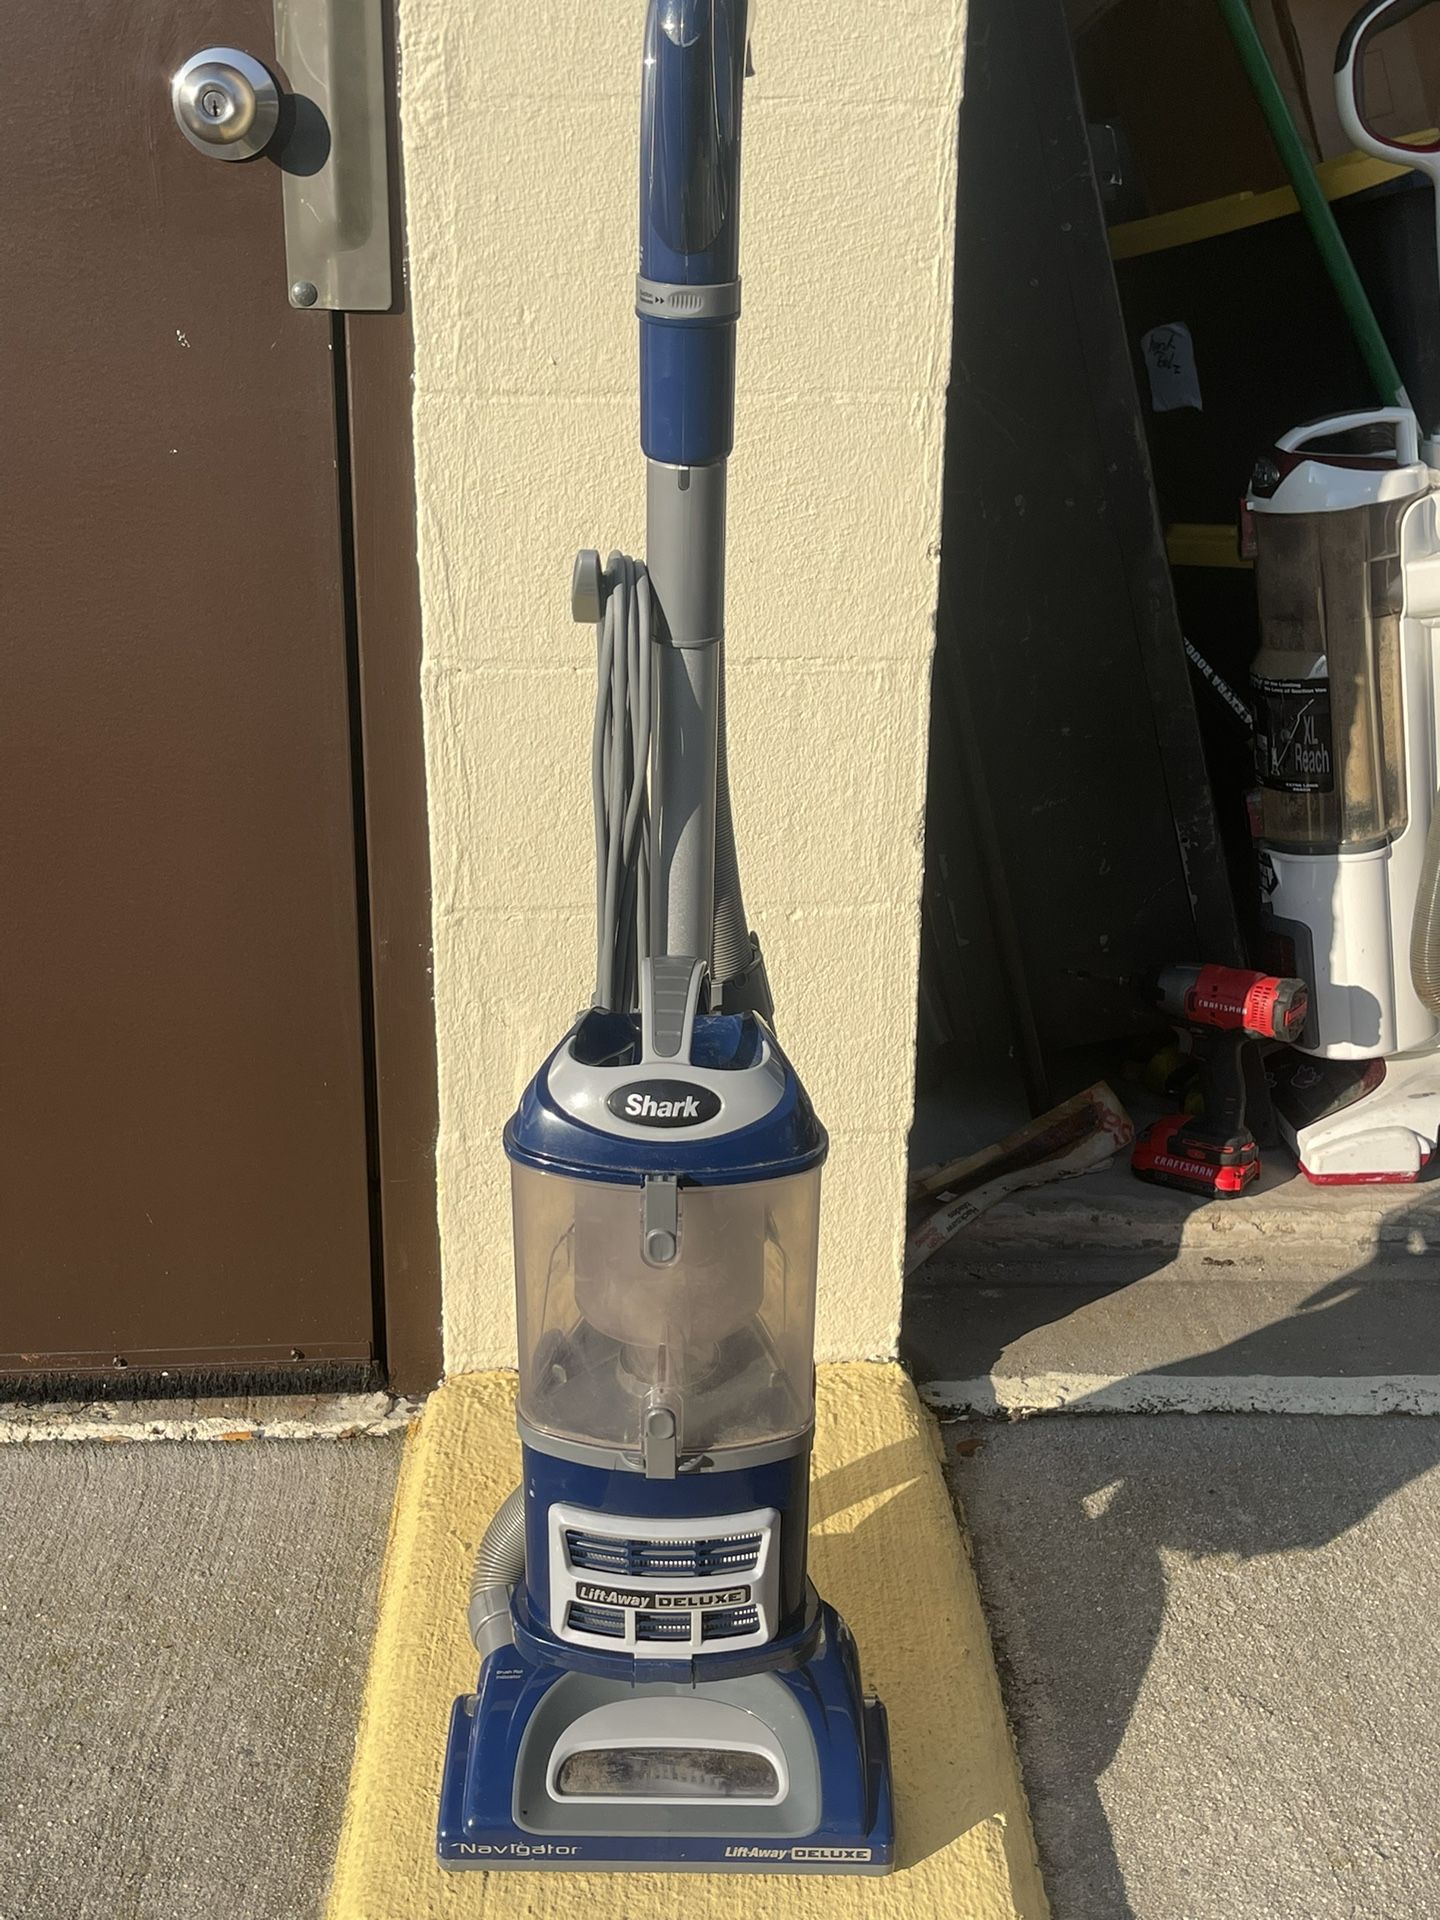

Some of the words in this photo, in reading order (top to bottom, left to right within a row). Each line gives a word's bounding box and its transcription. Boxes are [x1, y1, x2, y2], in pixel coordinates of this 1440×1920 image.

[1303, 715, 1319, 745] XL
[1295, 743, 1330, 773] Reach
[1198, 999, 1248, 1015] CRAFTSMAN
[624, 1093, 700, 1117] Shark
[1154, 1155, 1214, 1177] CRAFTSMAN
[579, 1586, 650, 1608] Lift-Away
[658, 1591, 743, 1607] DELUXE
[457, 1841, 580, 1857] Navigator
[724, 1846, 788, 1860] Lift-Away
[793, 1848, 869, 1859] DELUXE
